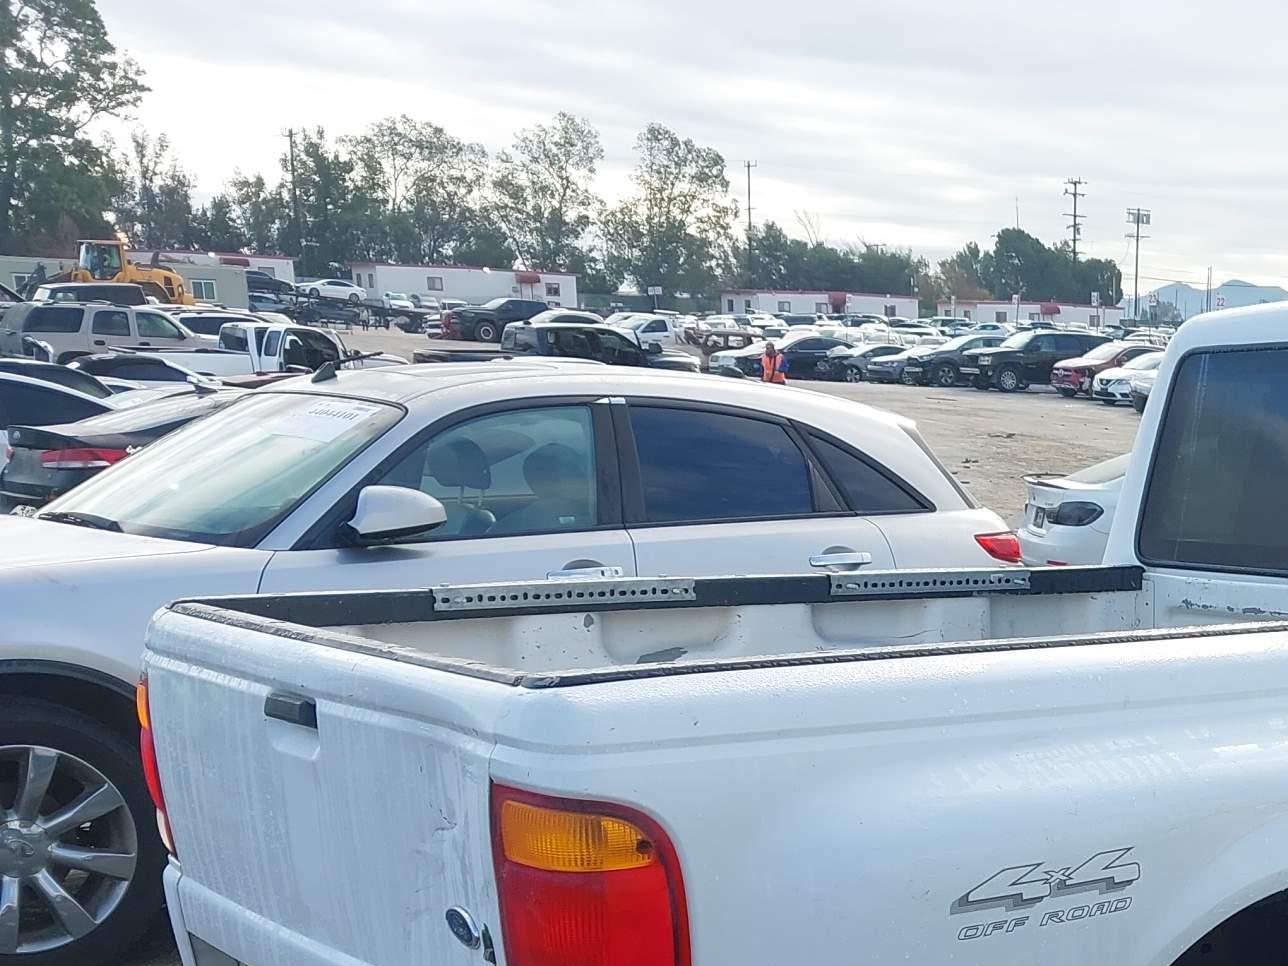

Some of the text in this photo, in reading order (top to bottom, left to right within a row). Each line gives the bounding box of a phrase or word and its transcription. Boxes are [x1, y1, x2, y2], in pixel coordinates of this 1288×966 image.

[1216, 297, 1225, 307] 22
[957, 896, 1133, 941] OFF ROAD
